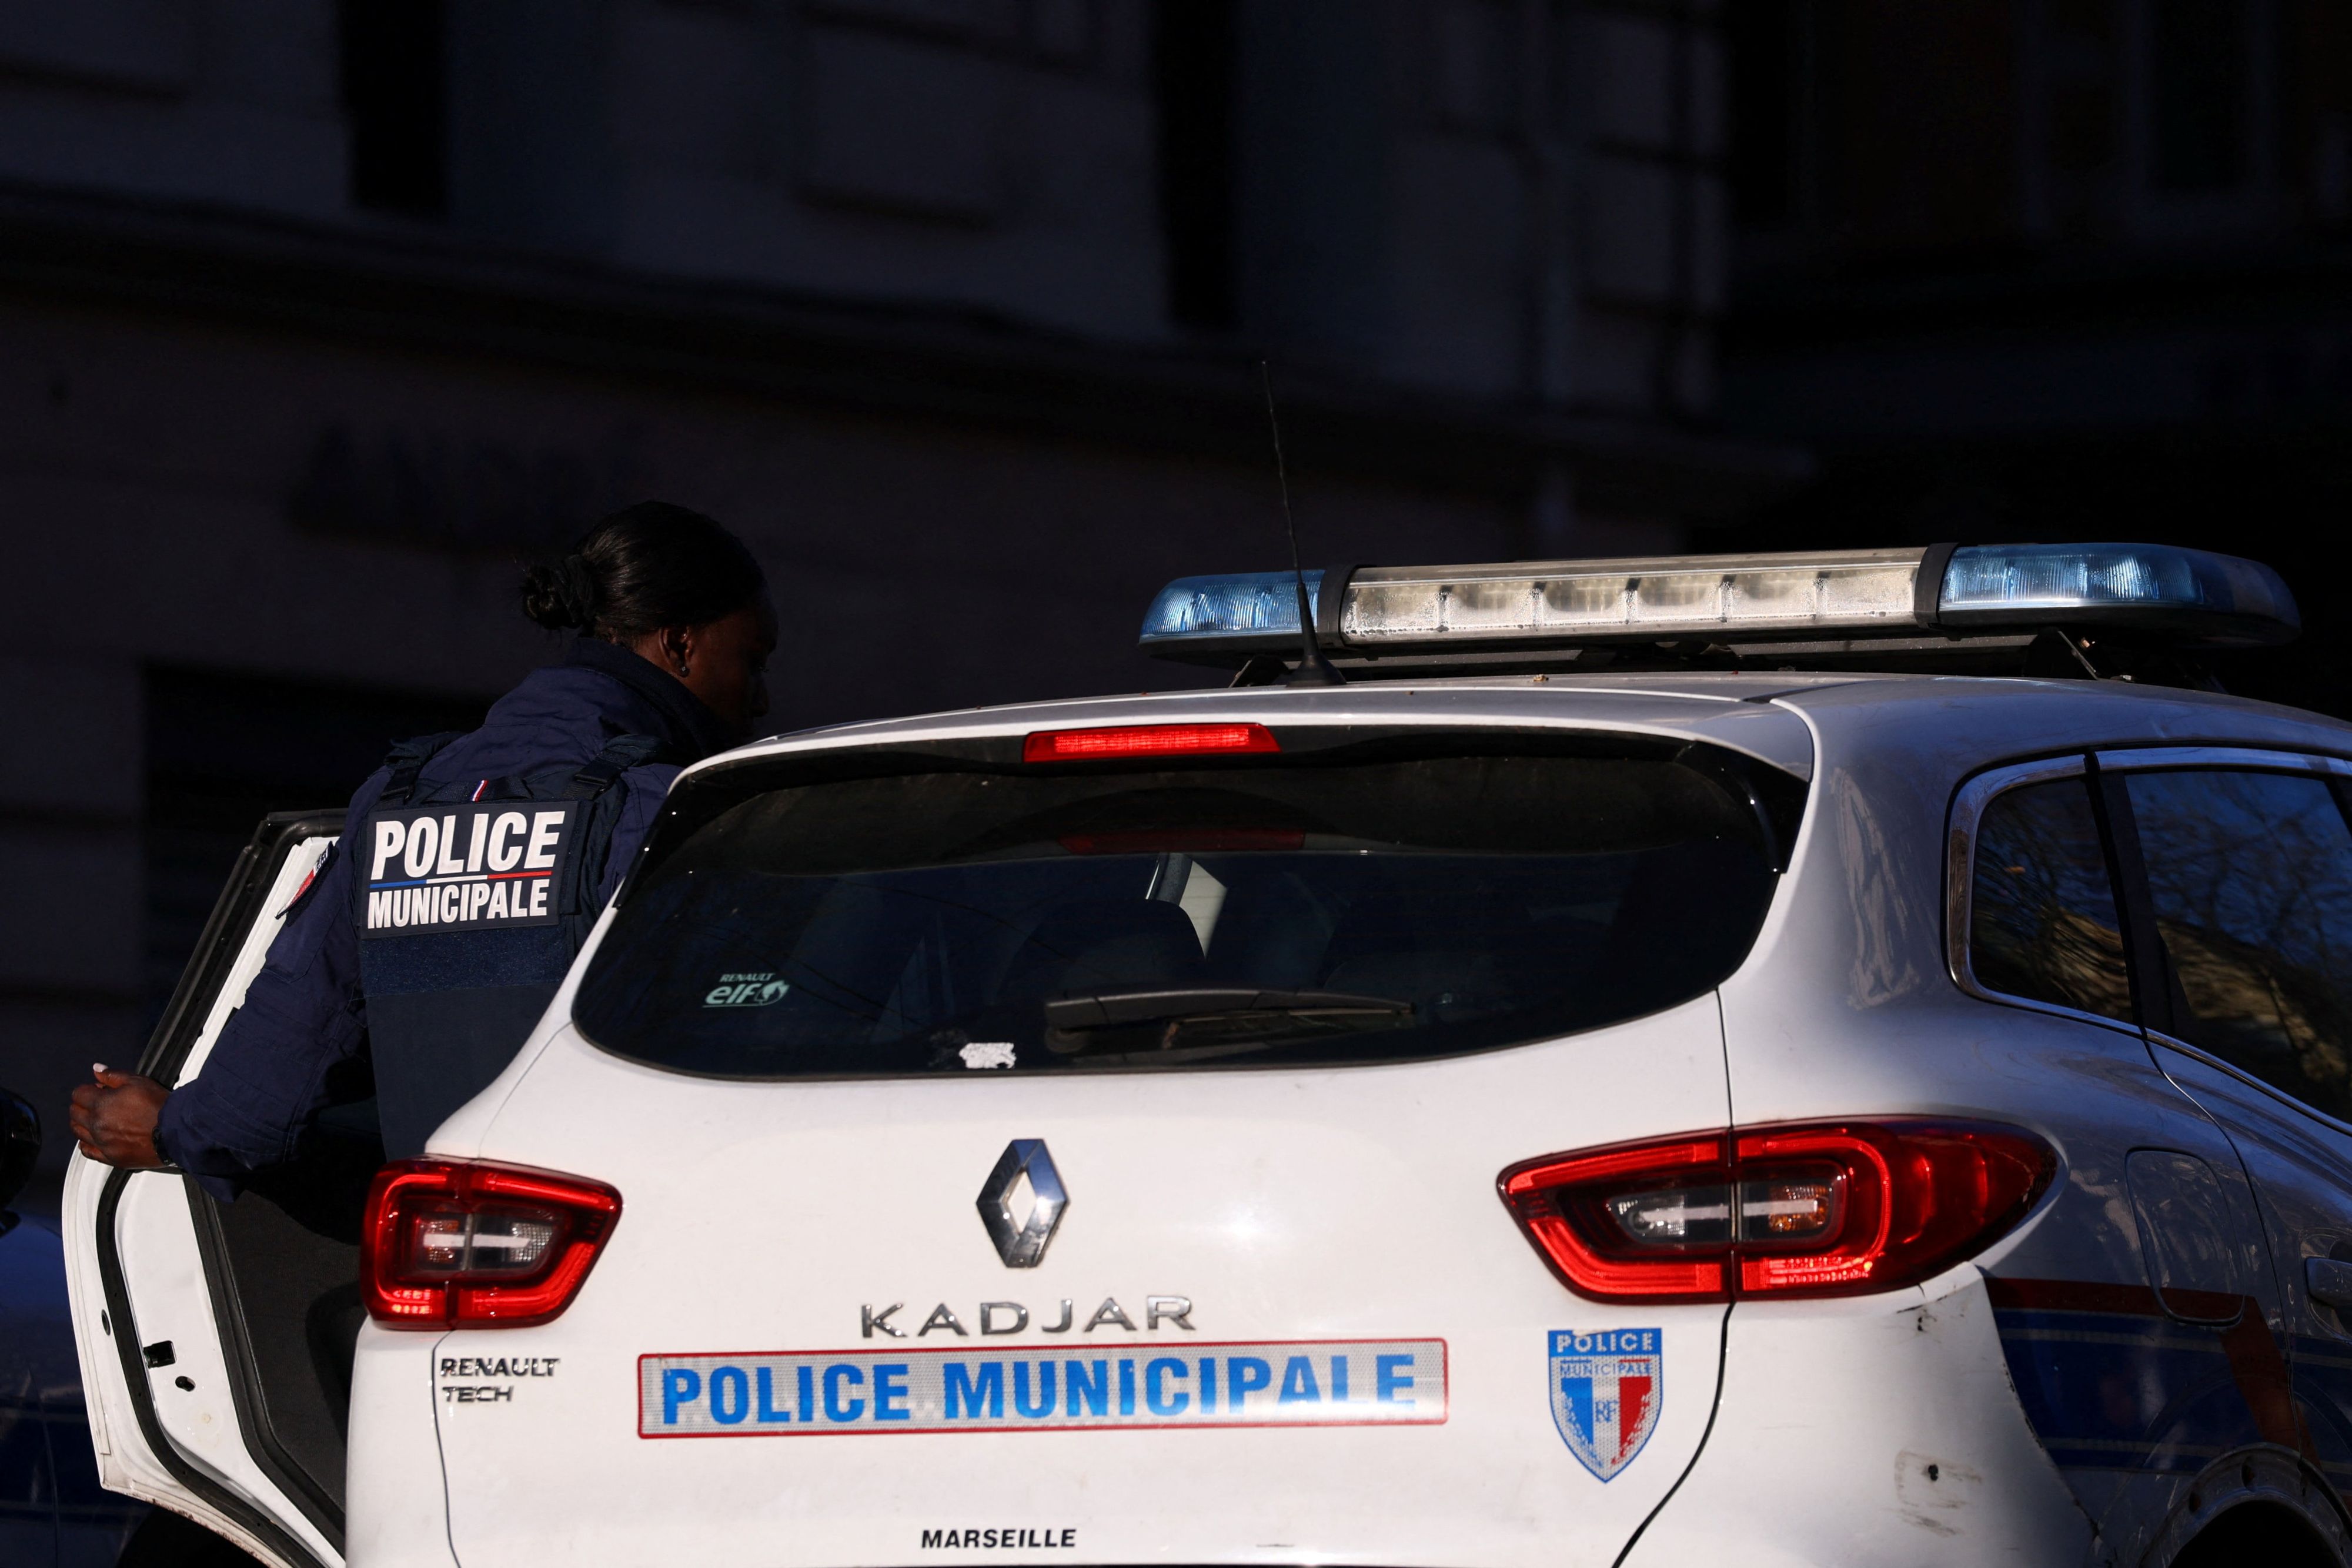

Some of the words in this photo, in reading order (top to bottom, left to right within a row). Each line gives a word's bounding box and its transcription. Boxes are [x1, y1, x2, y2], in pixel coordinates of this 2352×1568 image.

[370, 811, 566, 880] POLICE
[367, 879, 550, 930] MUNICIPALE
[720, 973, 774, 982] RENAULT
[861, 1295, 1196, 1338] KADJAR
[1556, 1333, 1653, 1353] POLICE
[440, 1358, 560, 1377] RENAULT
[1560, 1363, 1652, 1375] MUNICIPALE
[442, 1386, 514, 1402] TECH
[663, 1363, 910, 1425] POLICE
[943, 1354, 1416, 1419] MUNICIPALE
[921, 1529, 1076, 1549] MARSEILLE
